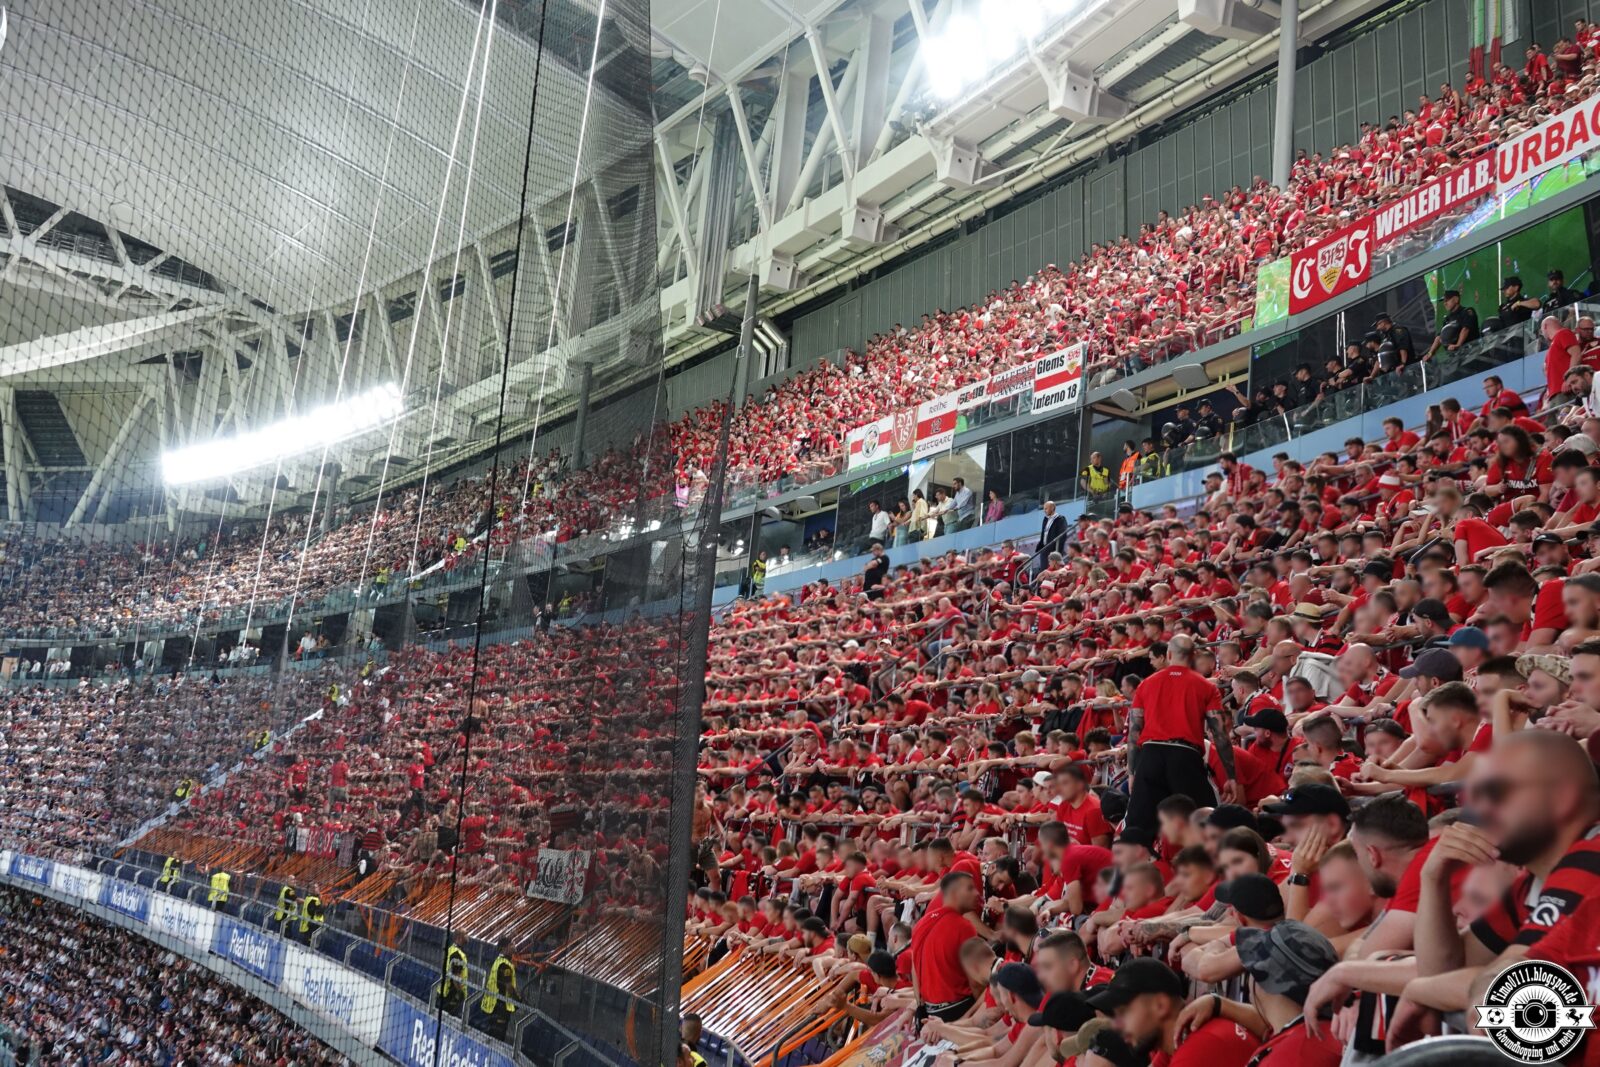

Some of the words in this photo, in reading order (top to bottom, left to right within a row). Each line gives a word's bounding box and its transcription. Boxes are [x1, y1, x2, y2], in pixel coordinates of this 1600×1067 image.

[1376, 186, 1441, 240] WEILER
[1444, 158, 1494, 206] i.d.B.
[1037, 354, 1065, 375] Glems
[1033, 390, 1065, 411] Inferno
[1067, 383, 1078, 399] 18
[229, 928, 245, 957] Real
[243, 935, 269, 970] Madrid
[303, 967, 323, 1003] Real
[324, 978, 355, 1025] Madrid
[410, 1018, 437, 1067] Rea
